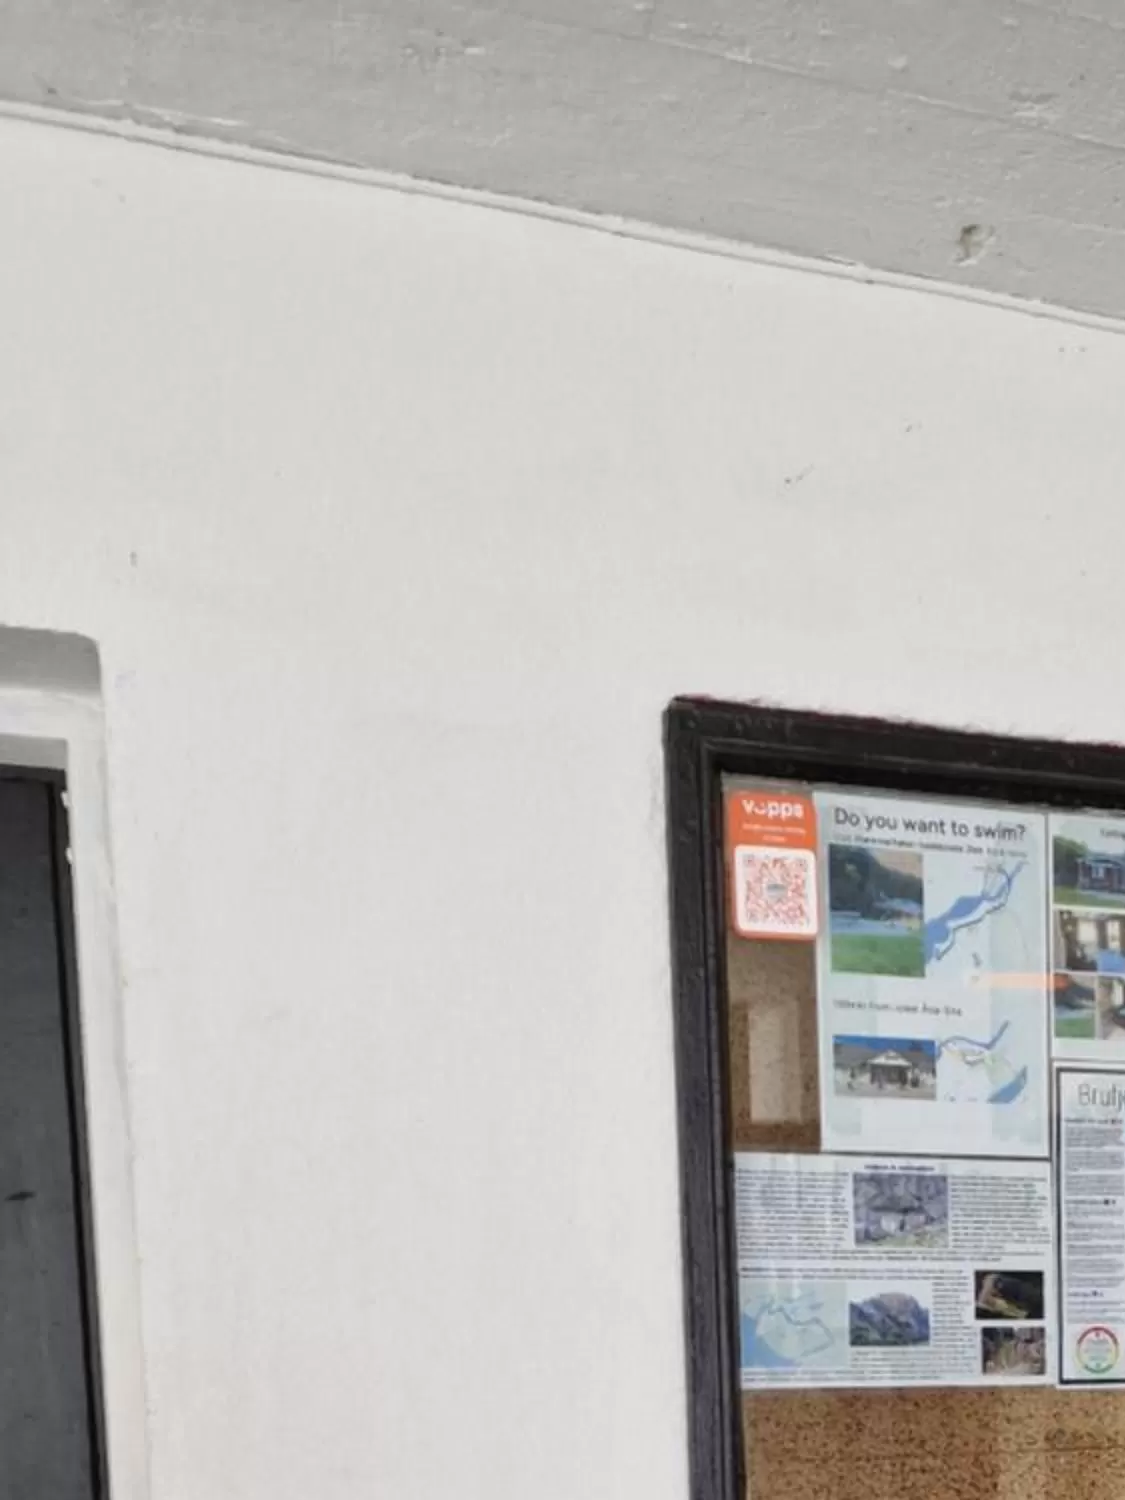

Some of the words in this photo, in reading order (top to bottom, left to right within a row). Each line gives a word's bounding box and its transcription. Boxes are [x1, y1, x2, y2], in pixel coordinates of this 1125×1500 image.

[834, 806, 860, 828] Do
[864, 813, 898, 832] you
[902, 817, 946, 835] want
[950, 819, 970, 837] to
[974, 823, 1027, 842] swim?
